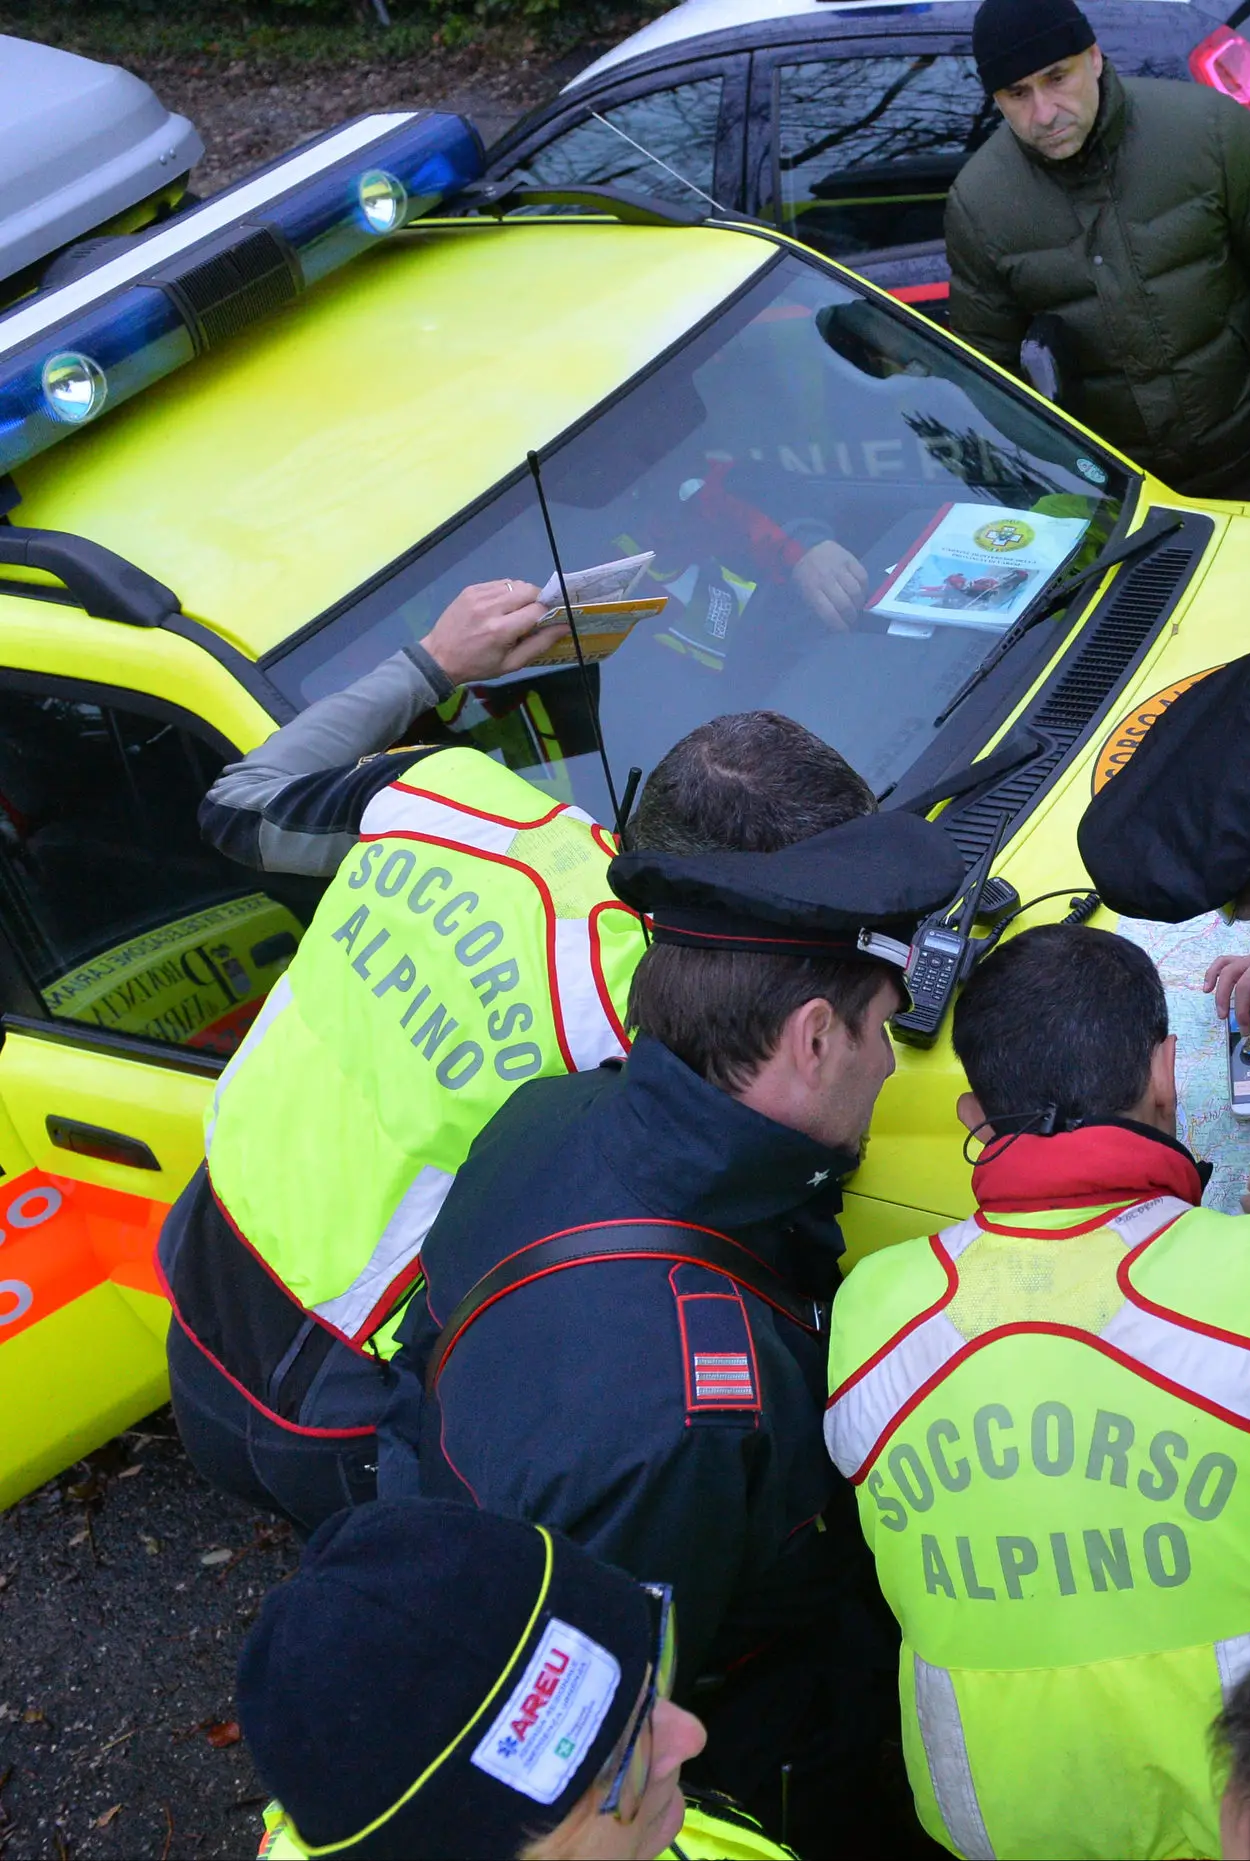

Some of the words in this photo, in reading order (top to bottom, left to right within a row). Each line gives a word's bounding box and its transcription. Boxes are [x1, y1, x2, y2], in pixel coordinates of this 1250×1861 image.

[331, 903, 484, 1090] ALPINO
[348, 843, 542, 1081] SOCCORSO
[868, 1401, 1238, 1532] SOCCORSO
[921, 1522, 1191, 1601] ALPINO
[511, 1648, 570, 1742] AREU
